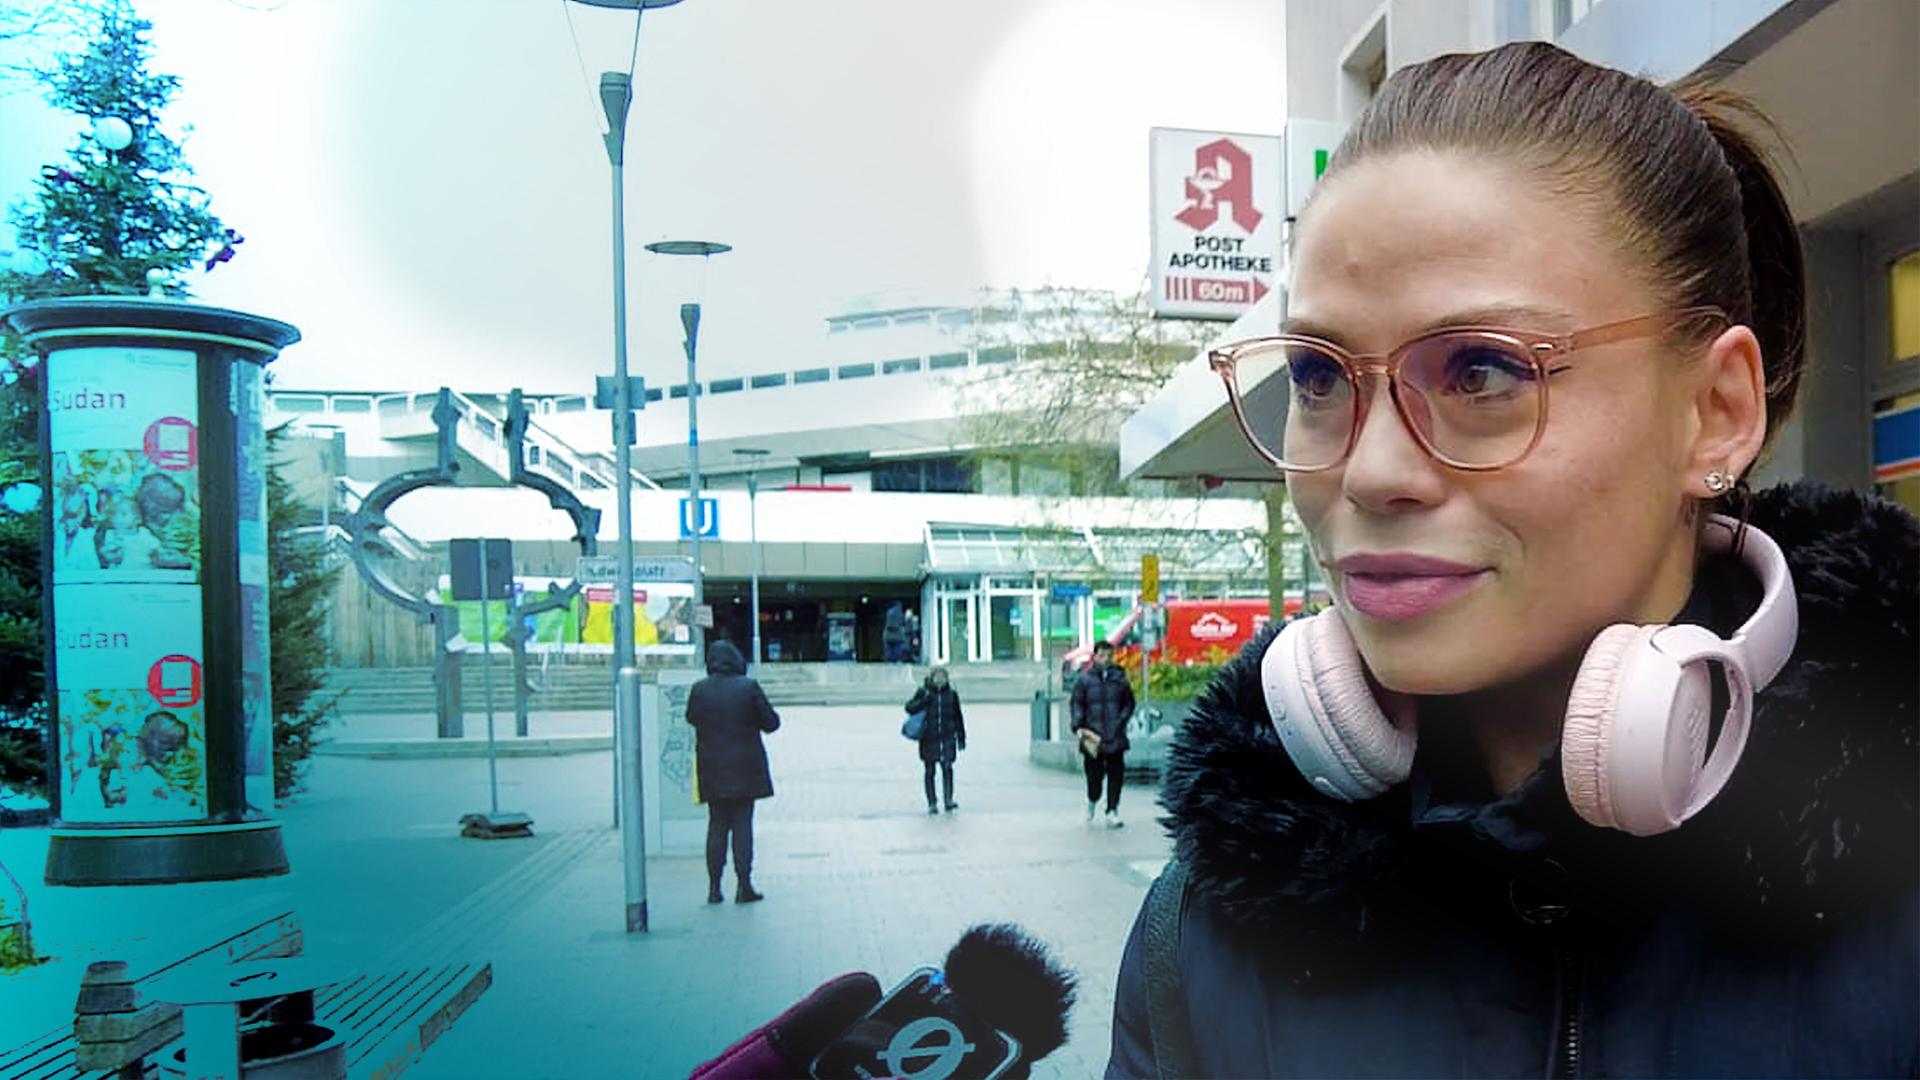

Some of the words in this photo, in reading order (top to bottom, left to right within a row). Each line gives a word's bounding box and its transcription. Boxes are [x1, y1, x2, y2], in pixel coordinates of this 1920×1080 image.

[1194, 236, 1245, 253] POST
[1169, 253, 1272, 273] APOTHEKE
[1198, 282, 1245, 301] 60m
[53, 386, 126, 412] Sudan
[685, 500, 712, 534] U
[56, 626, 129, 649] Sudan
